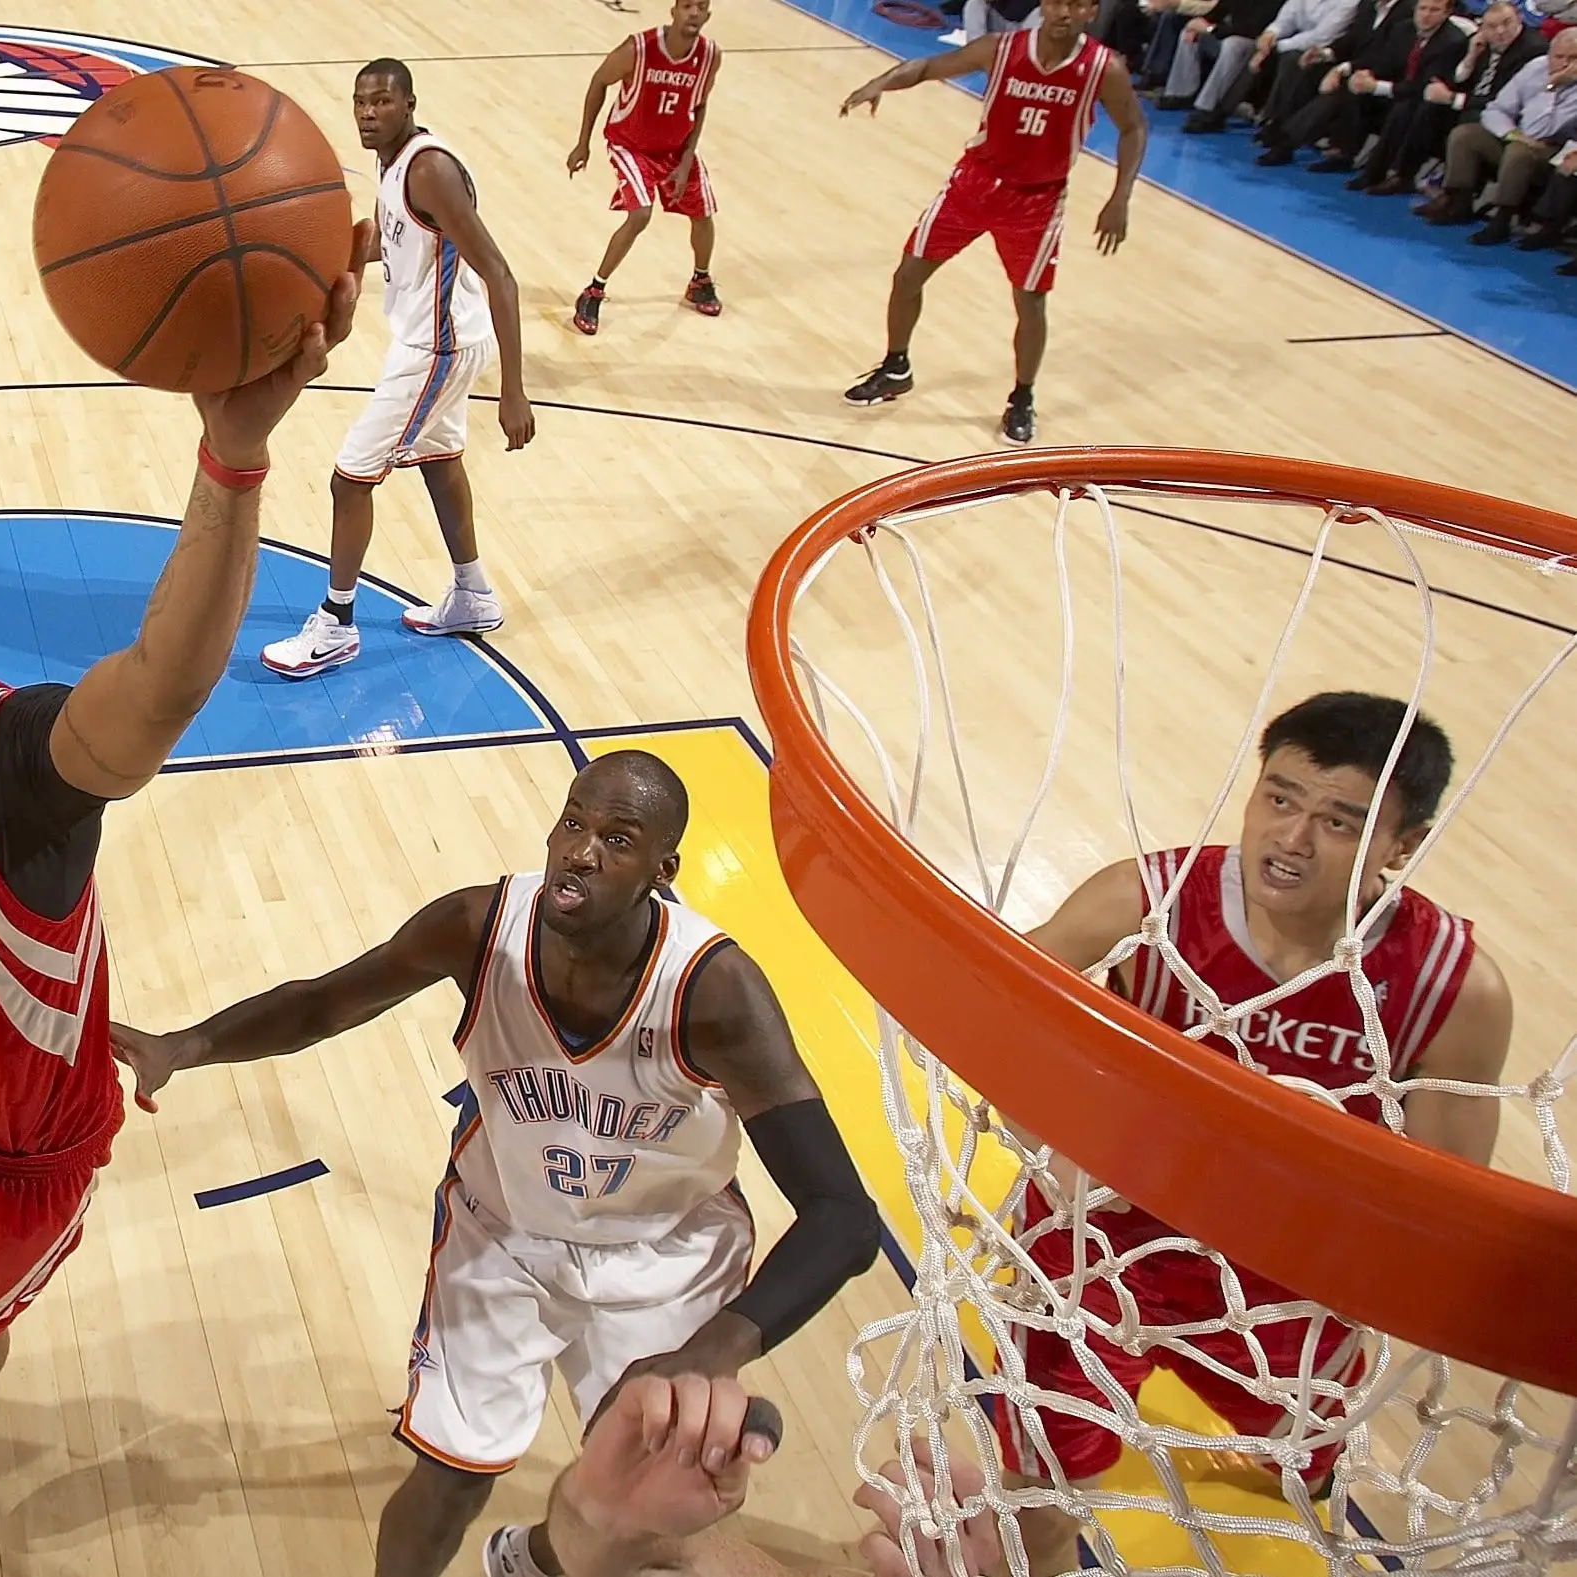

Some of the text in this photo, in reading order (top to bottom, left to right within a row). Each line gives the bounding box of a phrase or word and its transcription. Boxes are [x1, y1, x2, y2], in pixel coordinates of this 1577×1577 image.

[645, 67, 697, 88] ROCKETS
[1004, 76, 1077, 106] ROCKETS
[658, 91, 680, 115] 12
[1015, 106, 1050, 136] 96
[486, 1066, 693, 1143] THUNDER
[542, 1144, 636, 1200] 27
